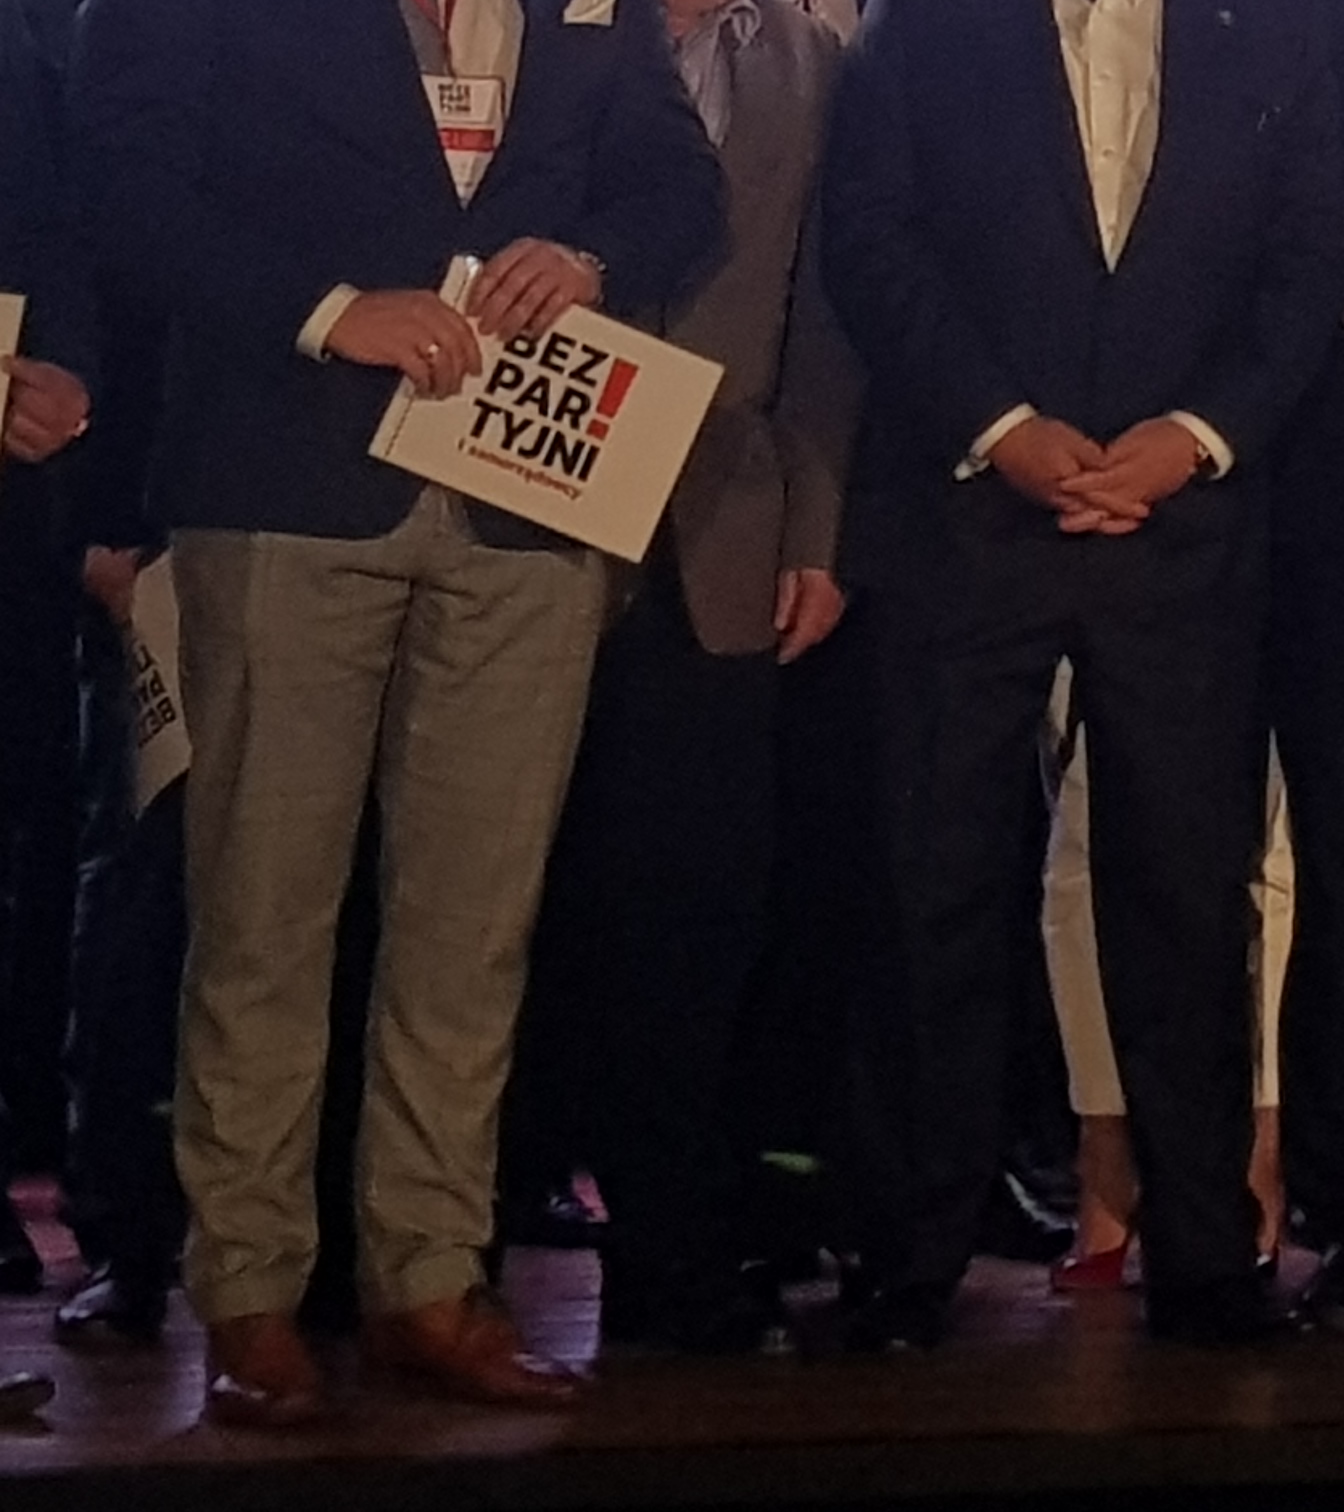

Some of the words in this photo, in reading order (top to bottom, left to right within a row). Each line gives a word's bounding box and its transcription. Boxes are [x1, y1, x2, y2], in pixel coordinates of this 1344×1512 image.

[484, 358, 592, 431] PAR
[502, 332, 610, 389] BEZ
[469, 396, 602, 483] TYJNI
